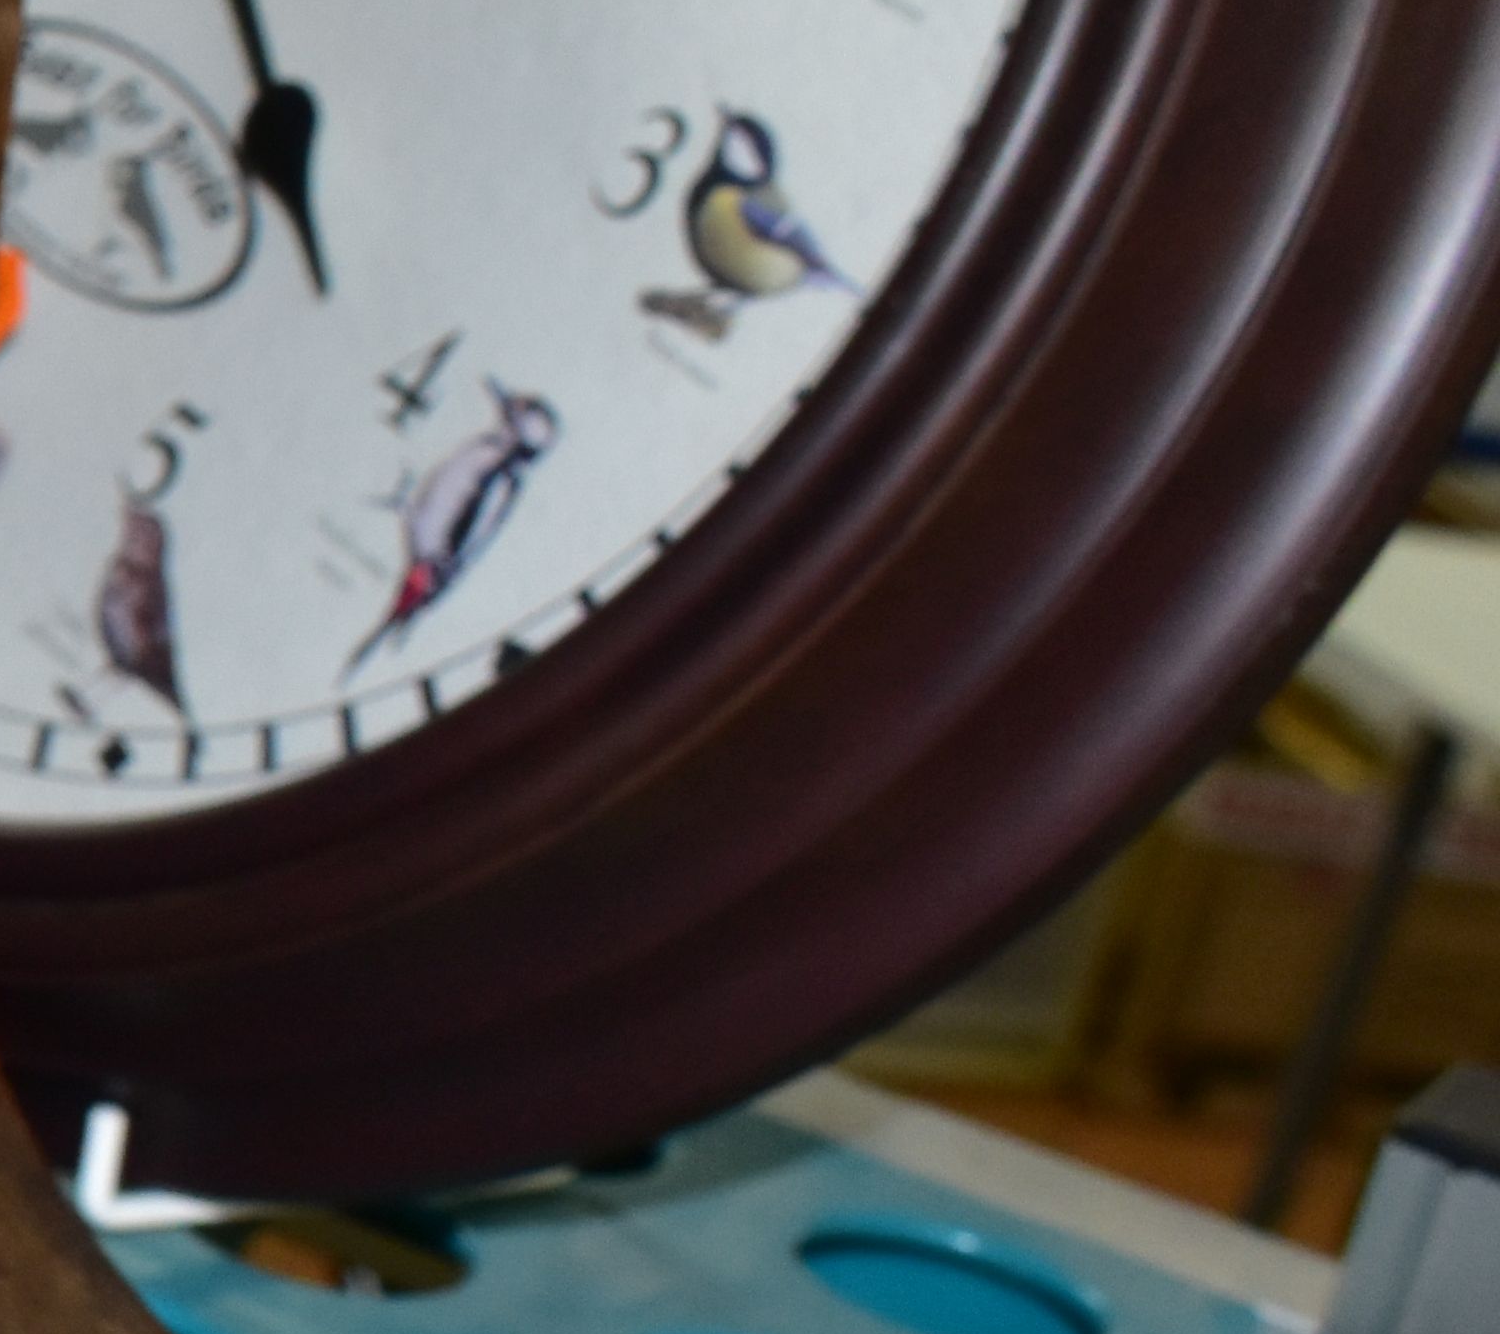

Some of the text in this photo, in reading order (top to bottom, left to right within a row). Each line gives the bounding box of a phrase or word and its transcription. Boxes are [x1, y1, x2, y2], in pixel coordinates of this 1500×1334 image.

[589, 106, 688, 220] 3
[378, 327, 466, 433] 4
[116, 401, 208, 503] 5
